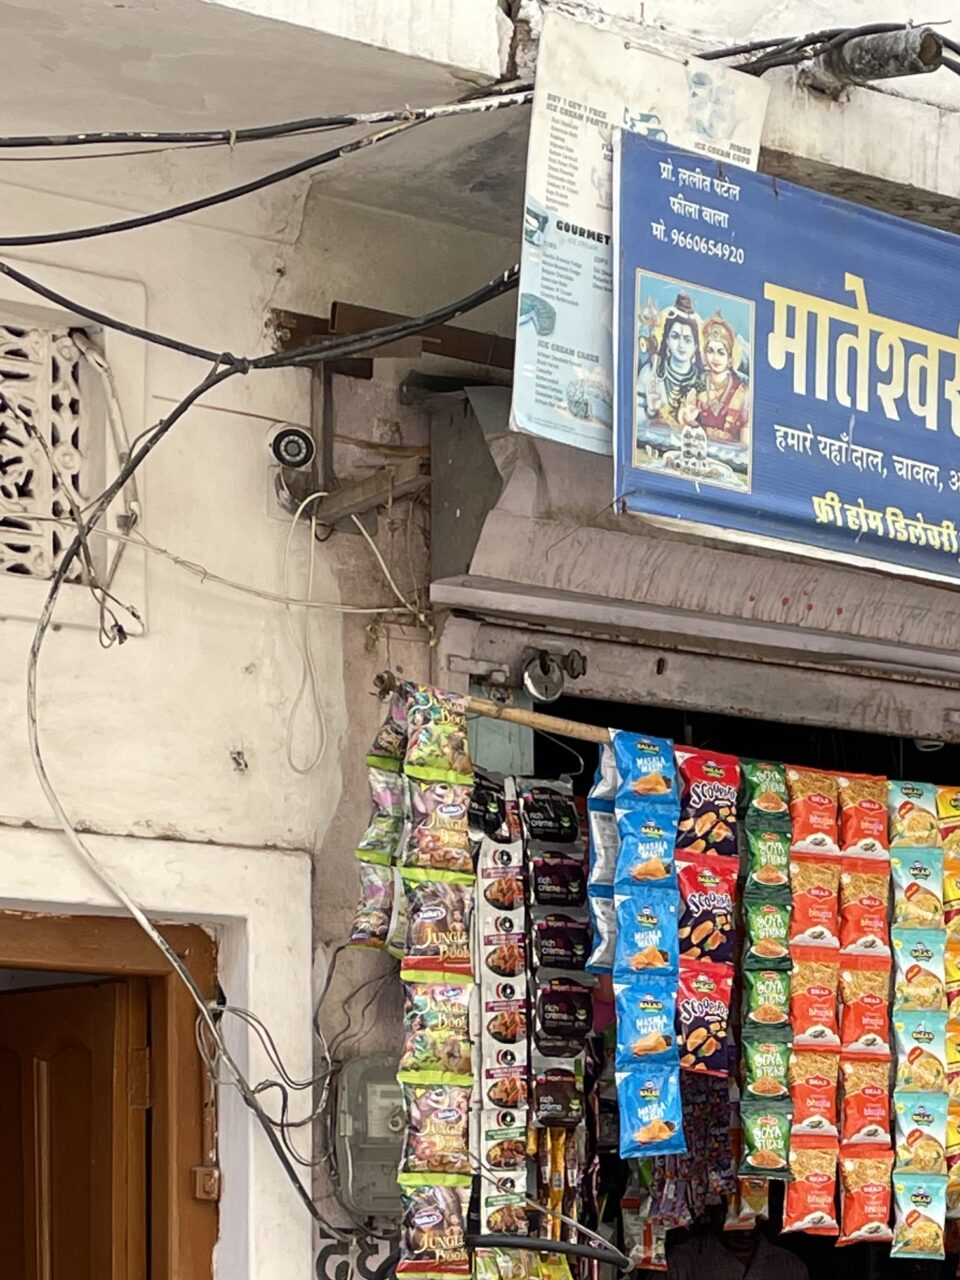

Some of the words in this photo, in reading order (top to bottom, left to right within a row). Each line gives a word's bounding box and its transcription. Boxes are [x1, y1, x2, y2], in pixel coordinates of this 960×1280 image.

[713, 176, 741, 202] पटेल
[556, 220, 612, 246] GOURMET
[702, 206, 729, 229] वाला
[670, 228, 746, 265] 9660654920
[774, 424, 814, 455] हमारे
[817, 432, 850, 466] यहाँ
[893, 455, 944, 493] चावल,
[844, 498, 884, 536] होम
[885, 506, 957, 554] डिलेवरी
